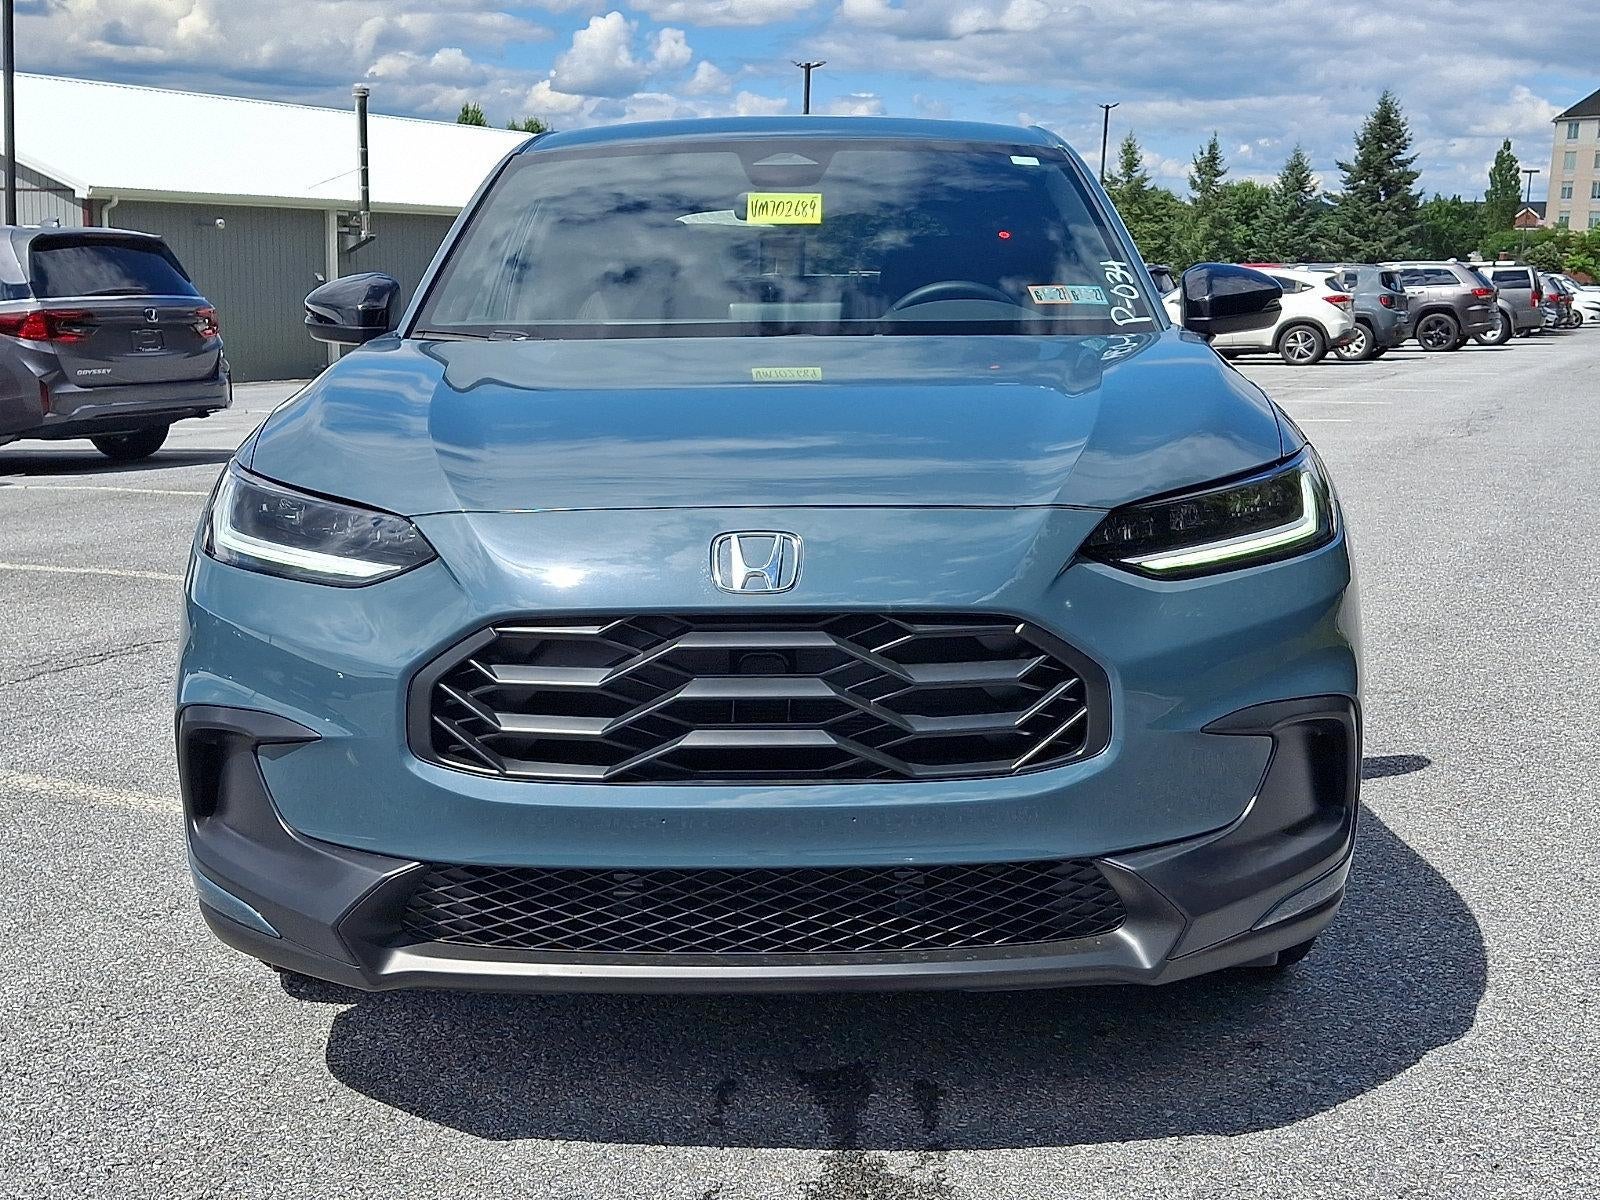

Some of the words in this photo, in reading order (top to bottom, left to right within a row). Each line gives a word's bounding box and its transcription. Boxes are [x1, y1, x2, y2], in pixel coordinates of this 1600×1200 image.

[751, 198, 817, 218] VM702689
[1056, 287, 1067, 301] 27
[1100, 261, 1152, 326] P-034
[76, 368, 112, 376] ODYSSEY
